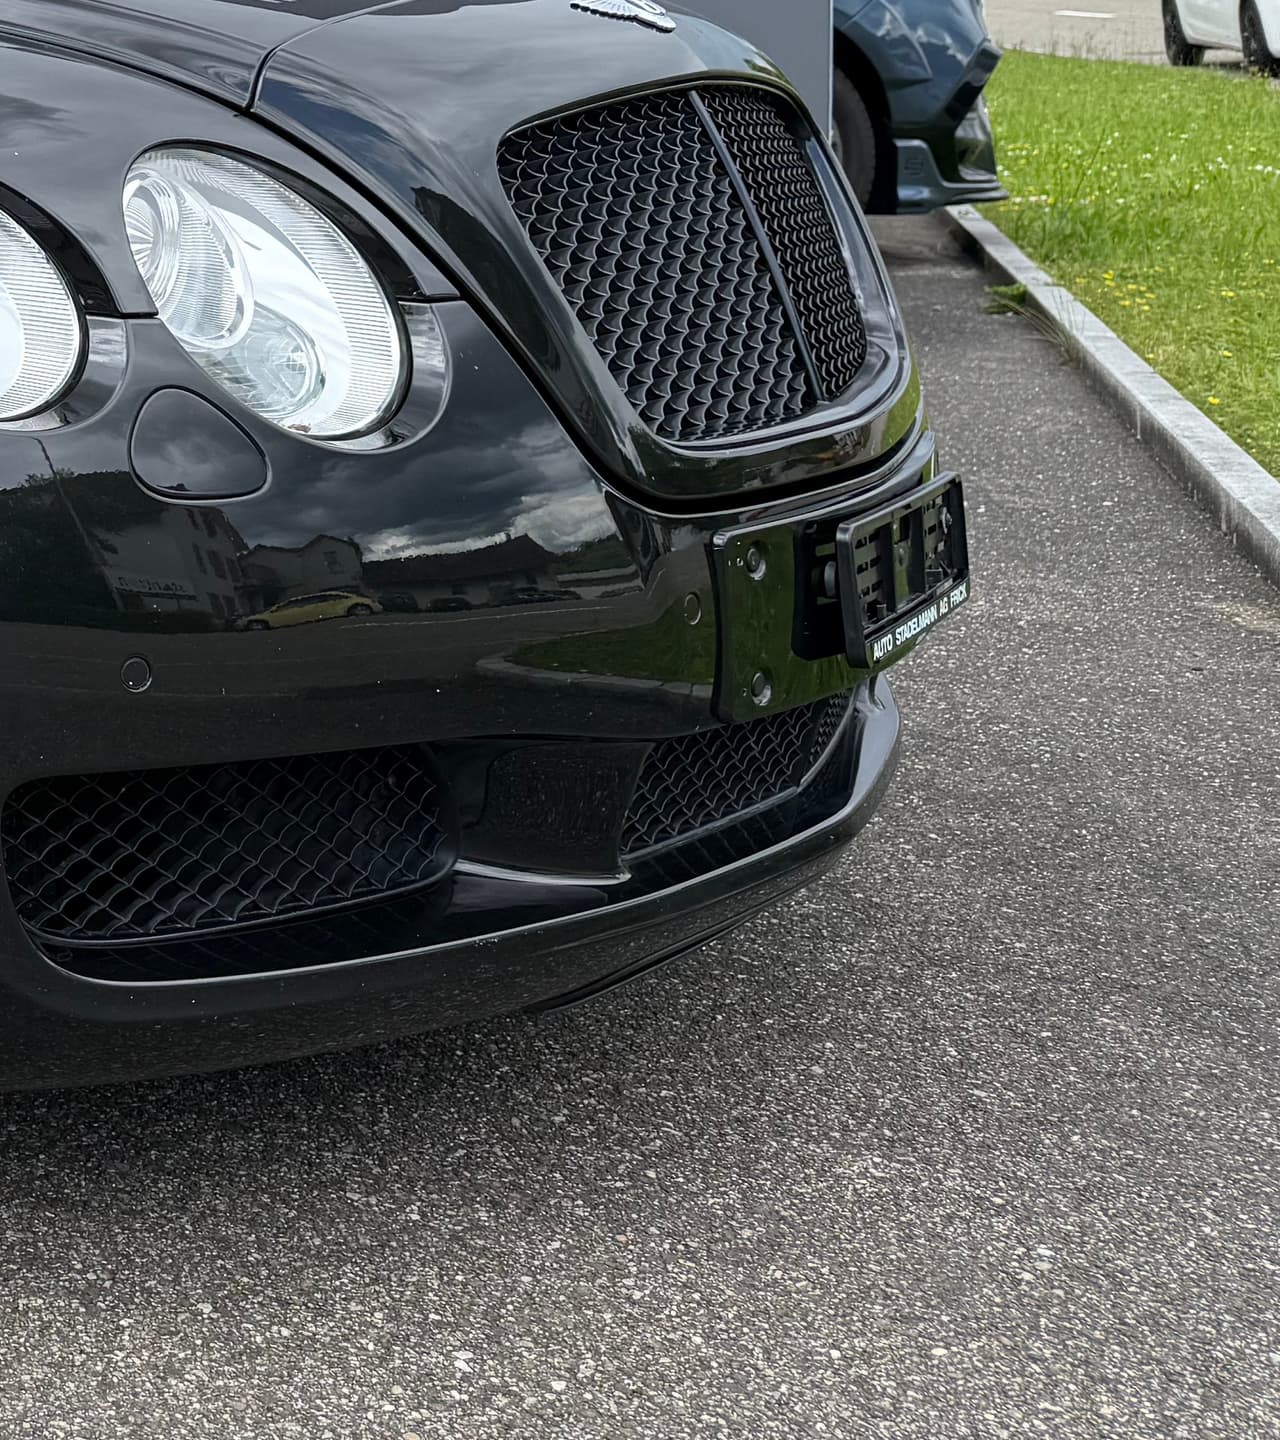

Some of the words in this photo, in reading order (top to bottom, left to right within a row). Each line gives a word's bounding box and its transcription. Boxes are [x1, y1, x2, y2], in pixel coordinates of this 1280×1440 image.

[873, 634, 893, 661] AUTO
[895, 604, 938, 646] STADELMANN
[939, 597, 949, 617] AG
[950, 582, 968, 608] FRICK
